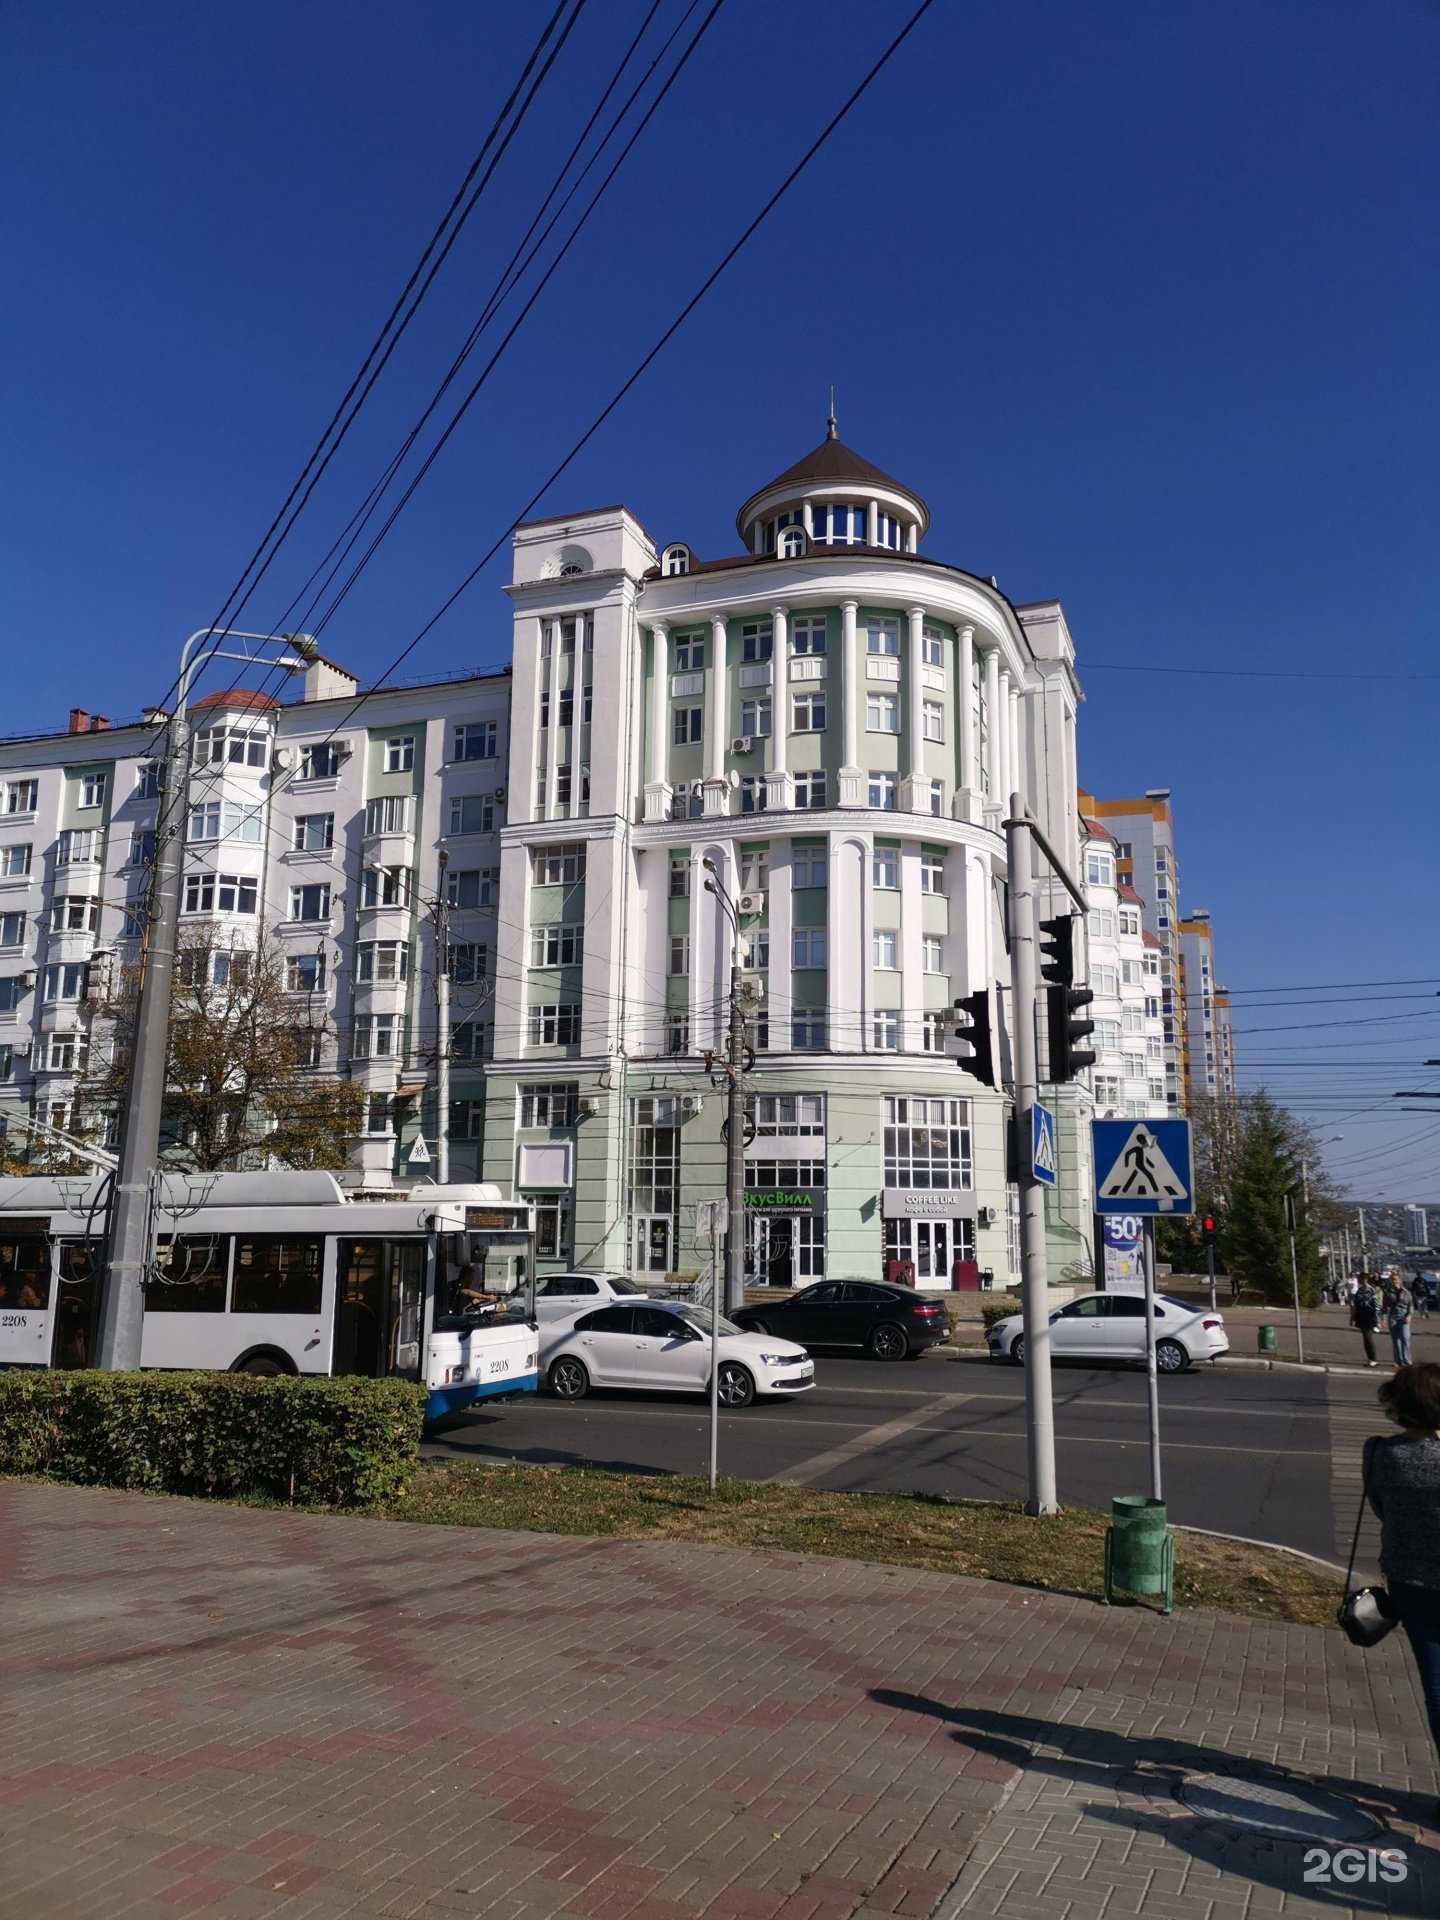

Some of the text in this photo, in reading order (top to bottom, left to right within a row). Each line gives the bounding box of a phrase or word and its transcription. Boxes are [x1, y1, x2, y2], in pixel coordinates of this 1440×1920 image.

[744, 1191, 812, 1206] ВкусВилл
[905, 1195, 960, 1204] COFFEE LIKE
[2, 1315, 27, 1327] 2208
[490, 1359, 509, 1373] 2208
